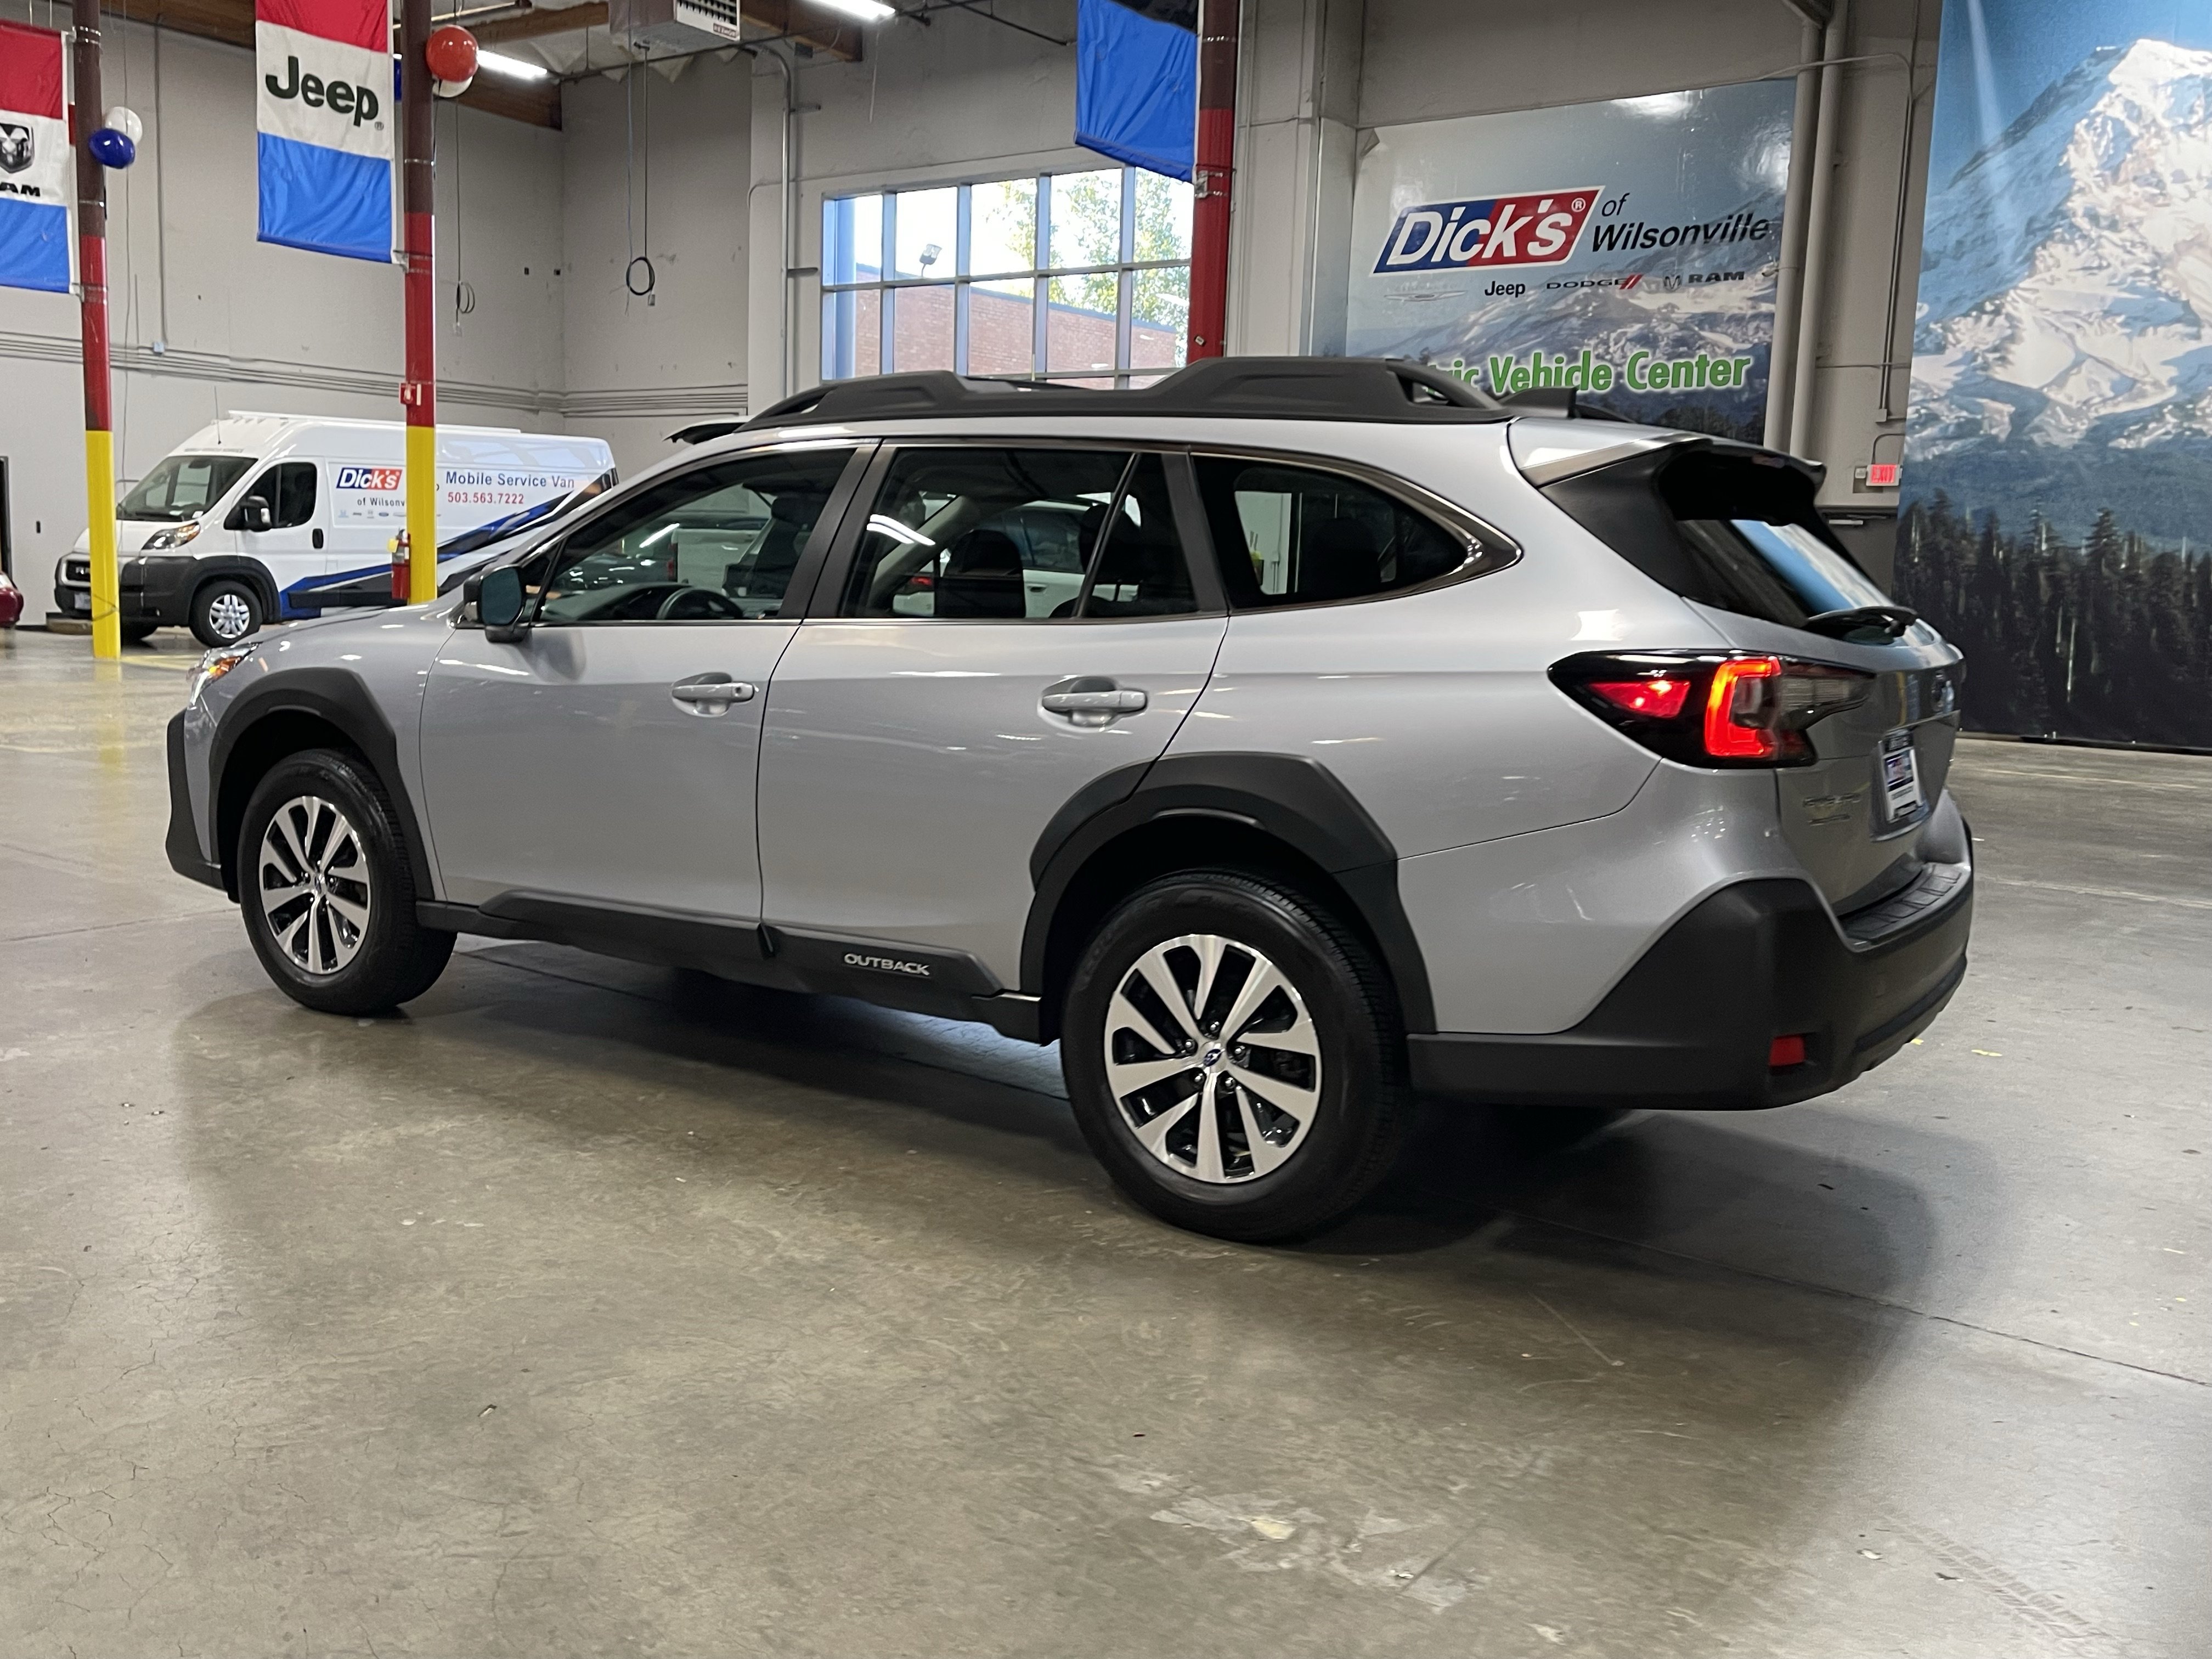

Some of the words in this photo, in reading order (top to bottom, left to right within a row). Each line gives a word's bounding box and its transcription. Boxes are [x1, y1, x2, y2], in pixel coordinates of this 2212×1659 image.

[266, 55, 379, 127] Jeep
[0, 182, 40, 196] AM
[1601, 193, 1629, 216] of
[1592, 213, 1769, 252] Wilsonville
[1485, 281, 1526, 297] Jeep
[1547, 278, 1628, 289] DODGE
[1688, 271, 1745, 284] RAM
[1489, 351, 1612, 393] Vehicle
[1627, 351, 1751, 390] Center
[446, 471, 492, 485] Mobile
[498, 473, 546, 487] Service
[551, 476, 574, 488] Van
[1871, 465, 1896, 483] EXIT
[357, 497, 366, 506] of
[370, 498, 405, 506] Wilsonv
[448, 492, 524, 504] 503.563.7222
[844, 953, 930, 976] OUTBACK
